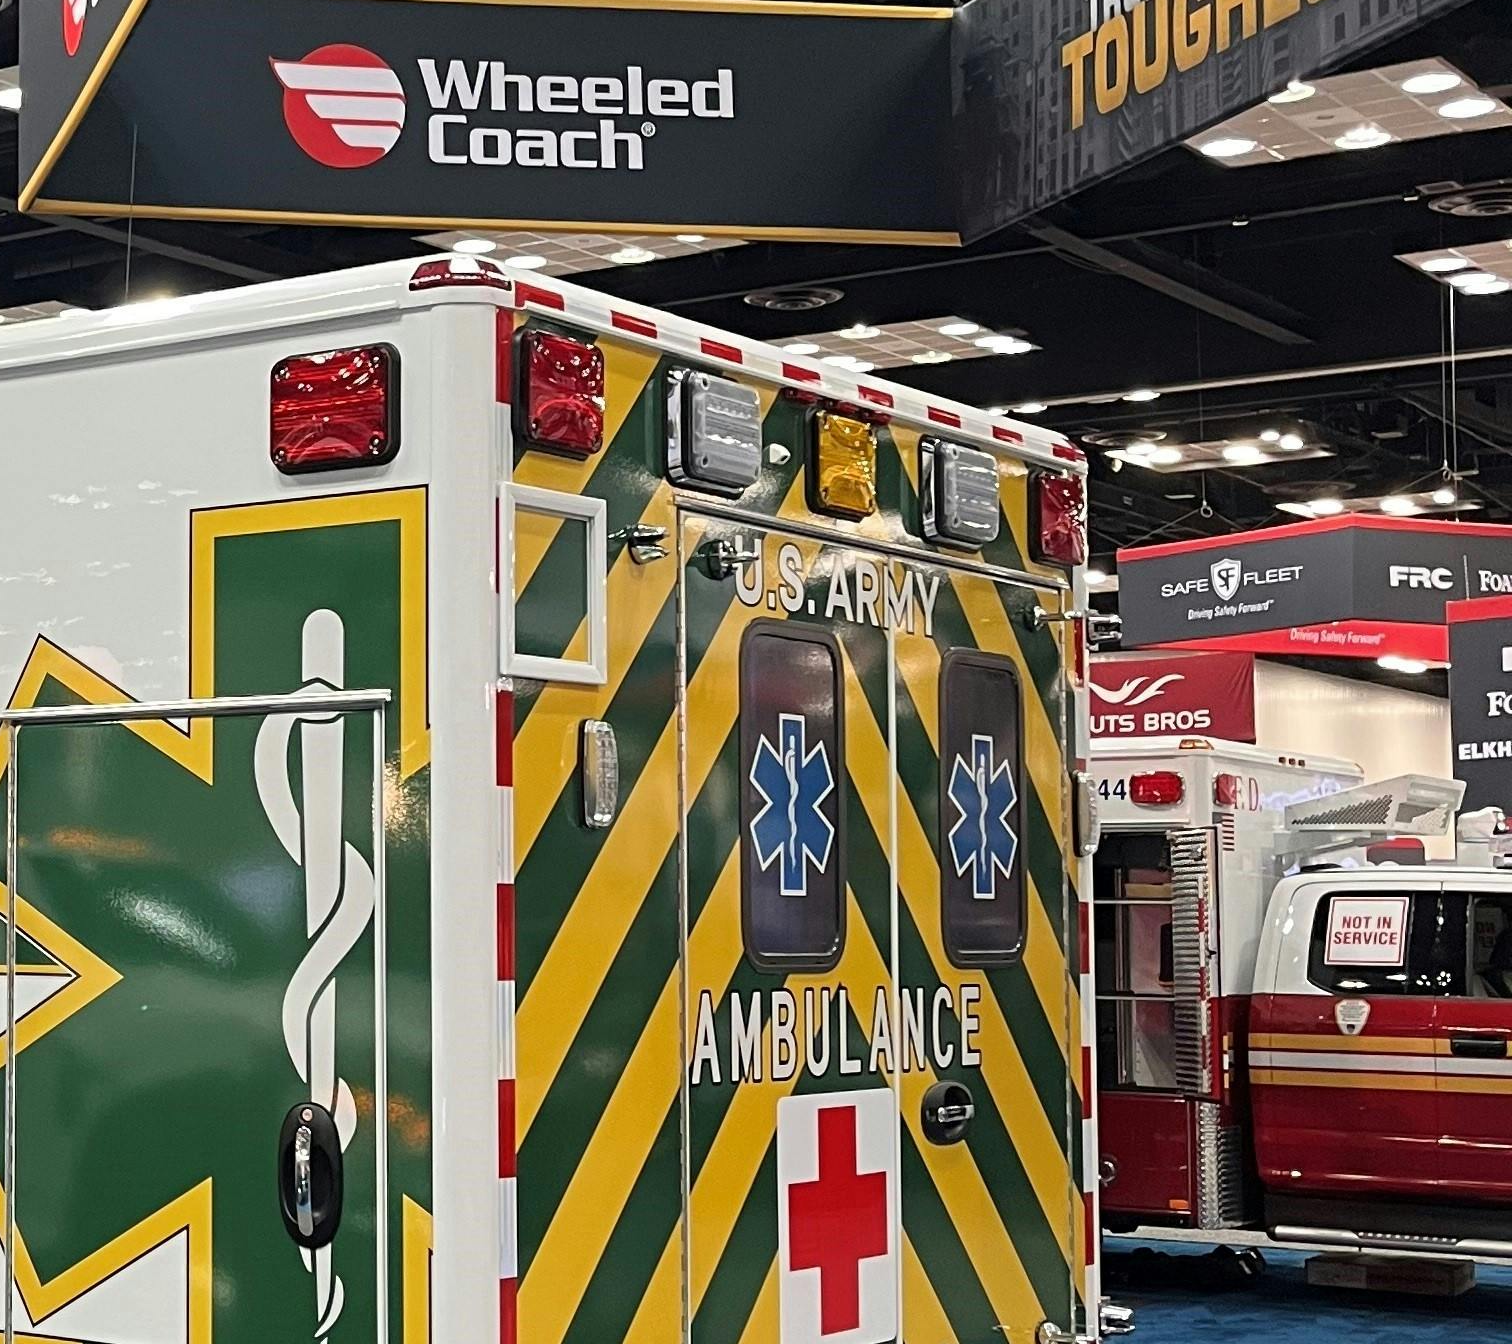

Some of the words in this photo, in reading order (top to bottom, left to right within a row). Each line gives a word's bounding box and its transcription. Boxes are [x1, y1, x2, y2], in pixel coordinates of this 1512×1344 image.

[416, 57, 736, 120] Wheeled
[734, 534, 816, 613] U.S.
[824, 554, 939, 637] ARMY
[1160, 578, 1210, 598] SAFE
[1243, 565, 1304, 586] FLEET
[1389, 564, 1454, 590] FRC
[1478, 569, 1512, 593] FOA
[1187, 608, 1214, 621] Driving
[1214, 604, 1238, 619] Safety
[1238, 600, 1270, 614] Forward
[1289, 627, 1320, 644] Driving
[1320, 629, 1347, 645] Safety
[1347, 631, 1383, 646] Forward
[1089, 713, 1136, 734] UTS
[1143, 709, 1211, 733] BROS
[1341, 915, 1373, 930] NOT
[1376, 915, 1393, 929] IN
[1332, 930, 1399, 946] SERVICE
[690, 983, 983, 1086] AMBULANCE
